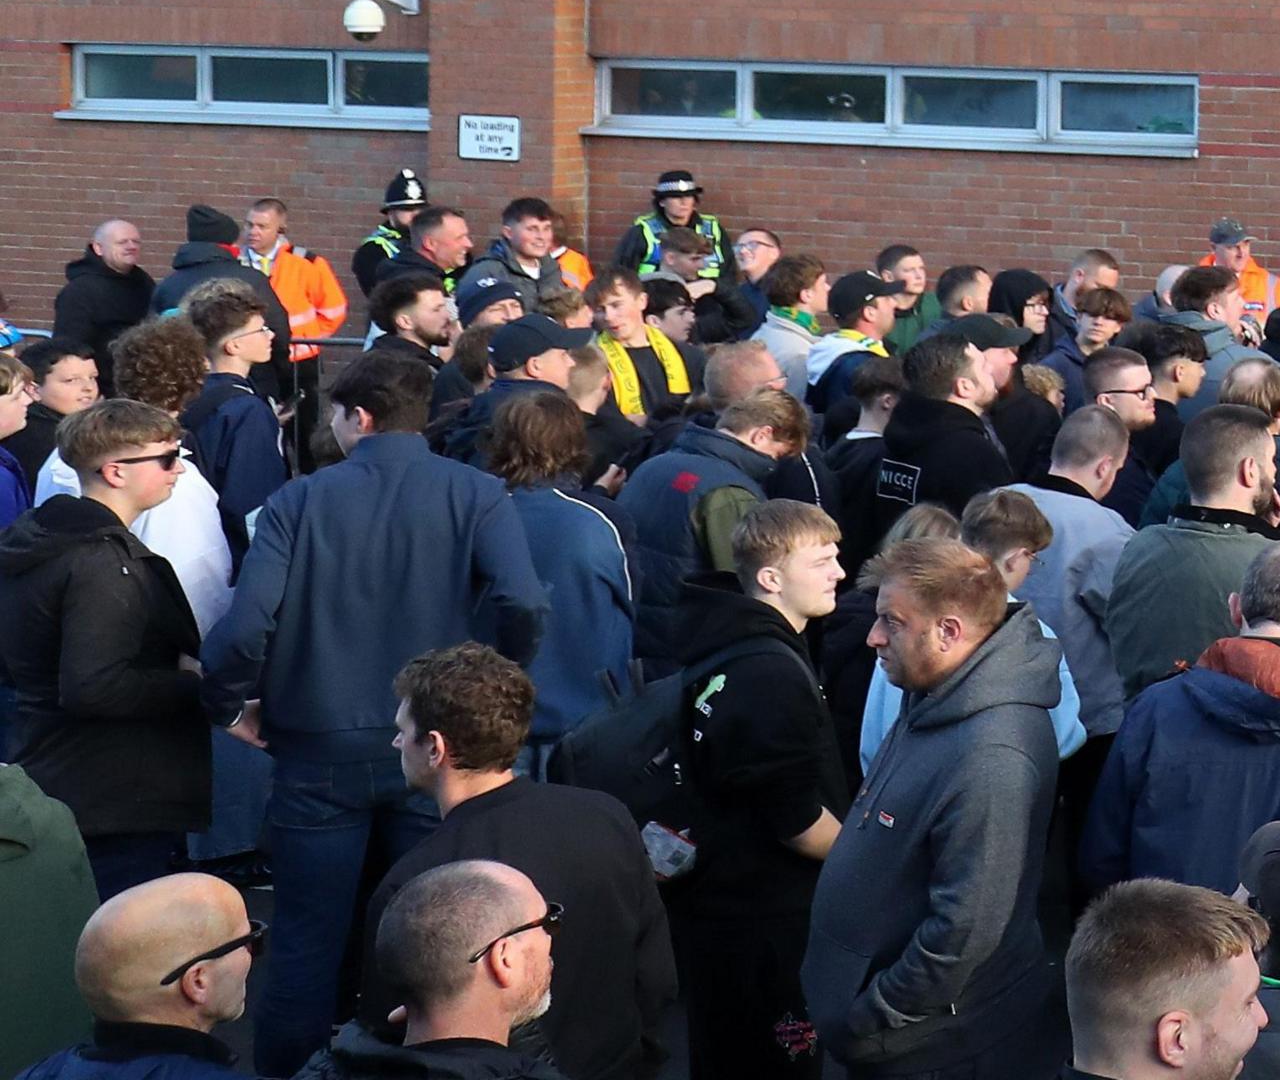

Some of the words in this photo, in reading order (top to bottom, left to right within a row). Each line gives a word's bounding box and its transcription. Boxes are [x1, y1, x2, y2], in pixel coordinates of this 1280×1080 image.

[480, 121, 515, 133] loading
[488, 134, 503, 145] any
[479, 145, 499, 154] time
[880, 470, 914, 490] NICCE
